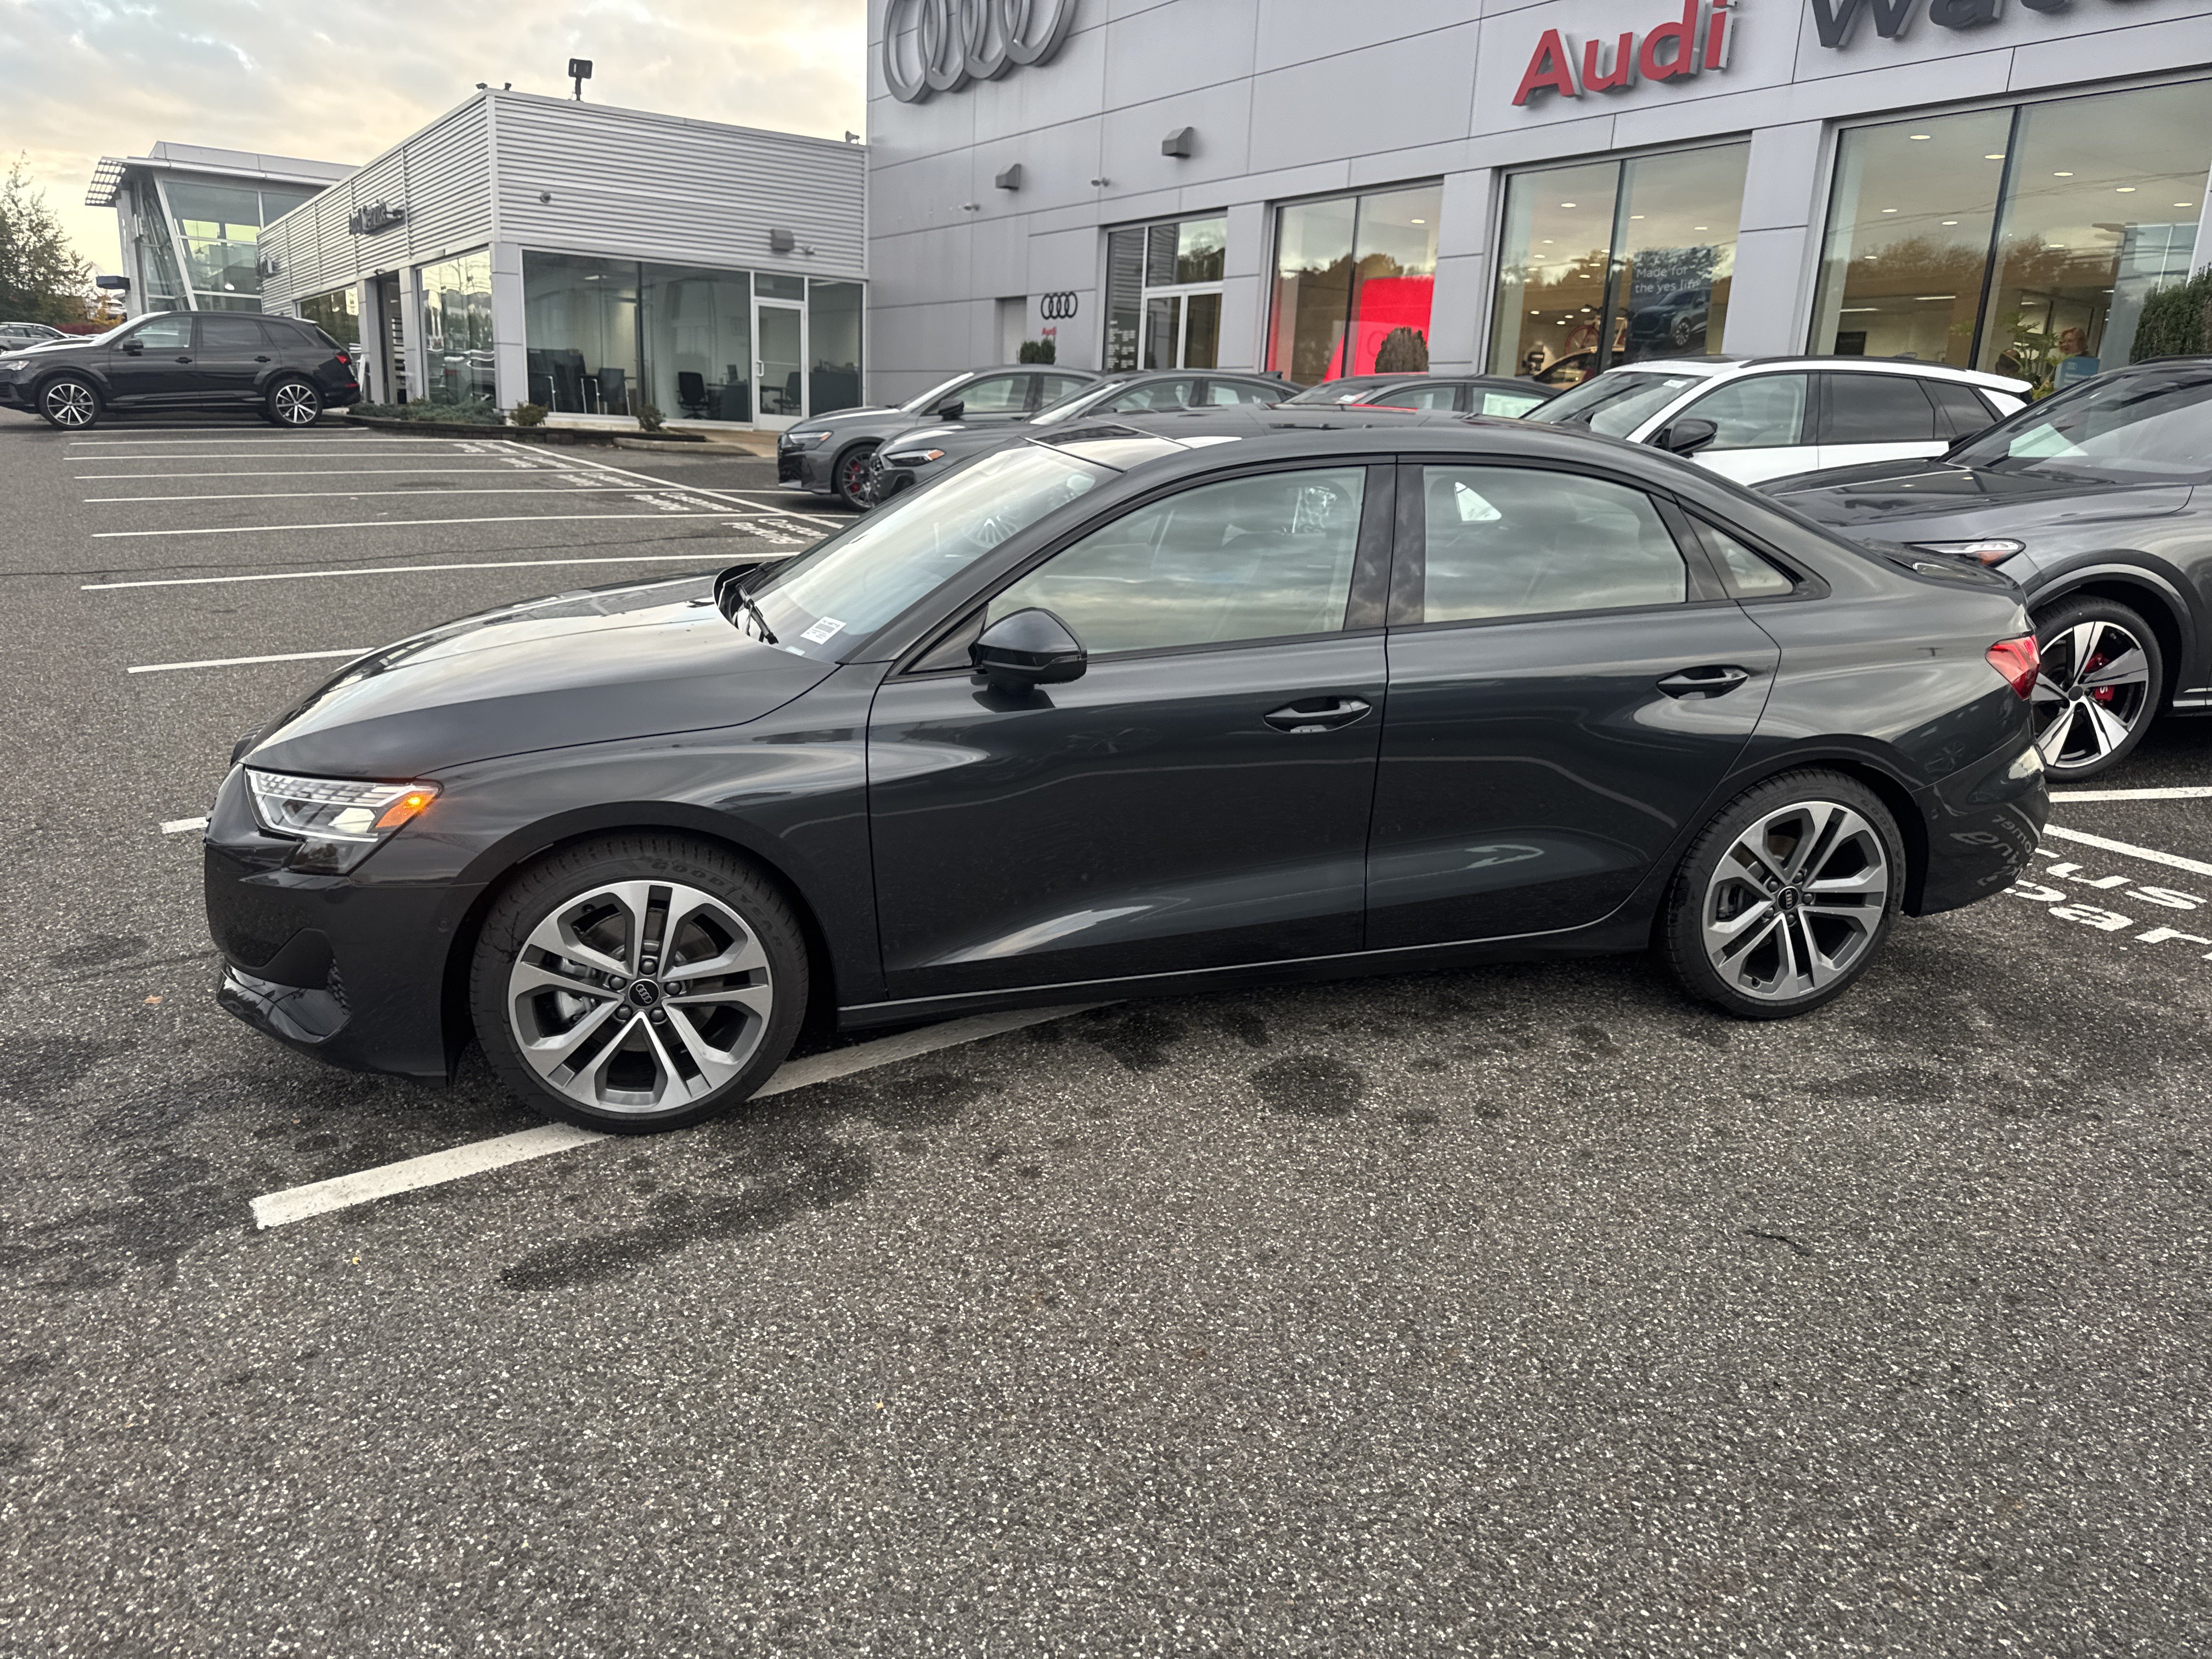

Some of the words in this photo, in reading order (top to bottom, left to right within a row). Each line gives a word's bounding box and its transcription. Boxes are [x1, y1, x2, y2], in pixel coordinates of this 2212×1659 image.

[1512, 0, 1734, 106] Audi
[1636, 267, 1668, 278] Made
[1671, 264, 1689, 276] for
[1635, 283, 1654, 294] the
[1657, 282, 1677, 295] yes
